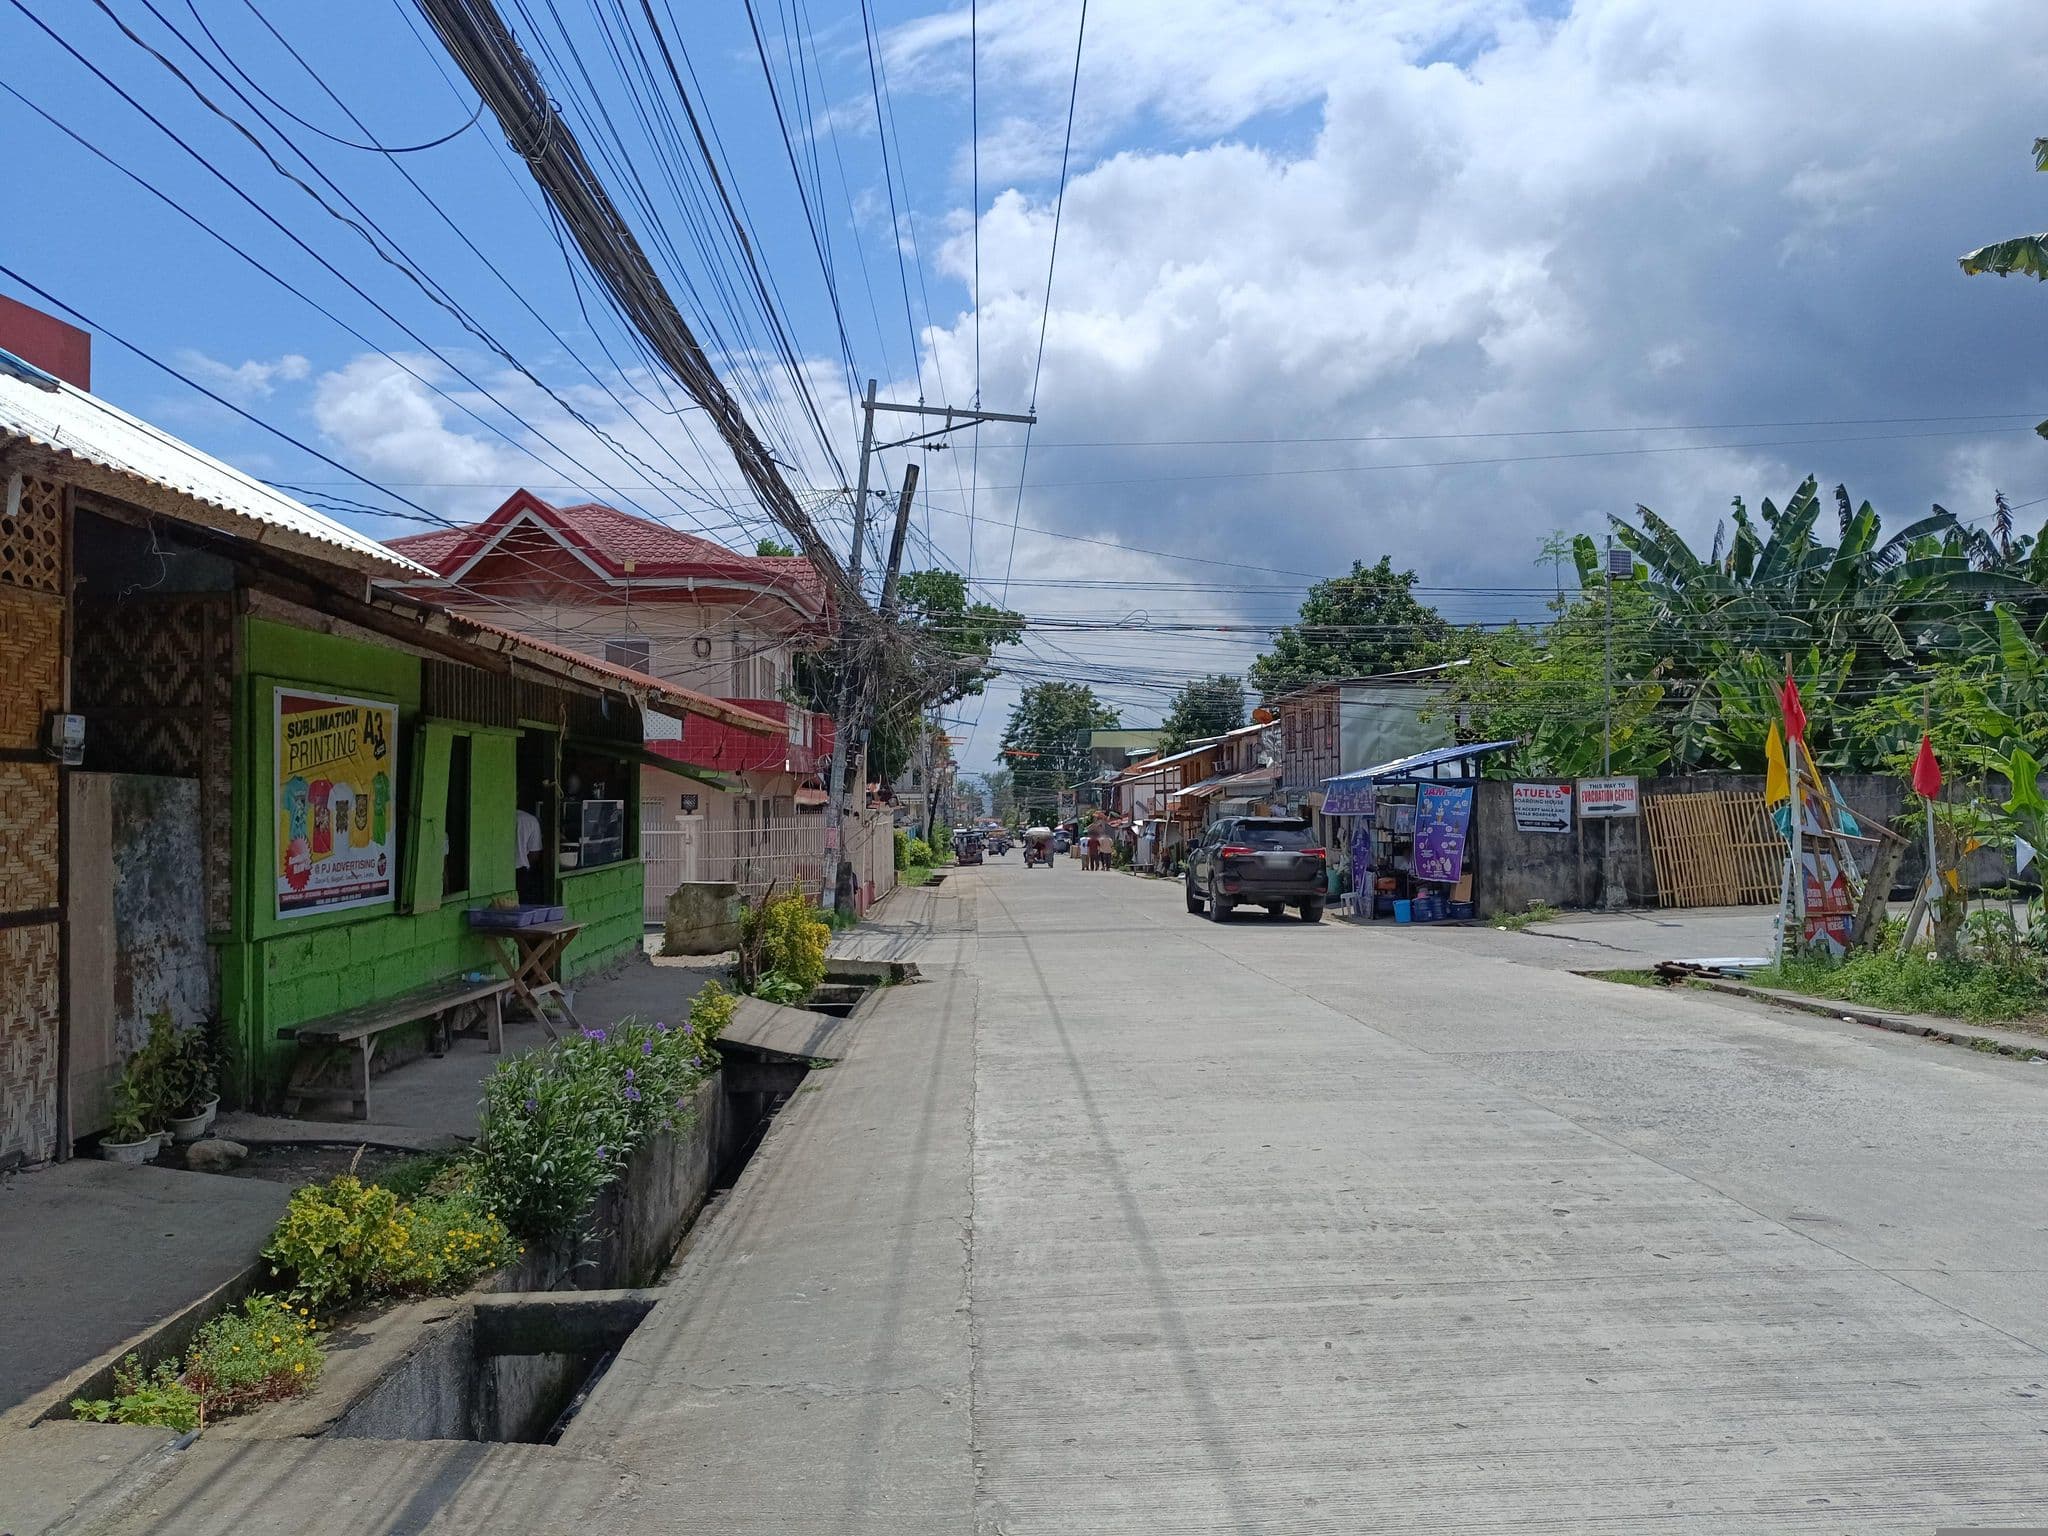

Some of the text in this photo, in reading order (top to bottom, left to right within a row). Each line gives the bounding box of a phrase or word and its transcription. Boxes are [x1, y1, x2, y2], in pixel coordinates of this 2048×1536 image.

[287, 708, 358, 740] SUBLIMATION
[363, 710, 384, 745] A3
[289, 727, 357, 771] PRINTING
[1515, 788, 1562, 799] ATUEL'S
[1581, 789, 1634, 803] EVACUATION CENTER
[321, 863, 331, 873] PJ
[332, 858, 376, 872] ADVERTISING
